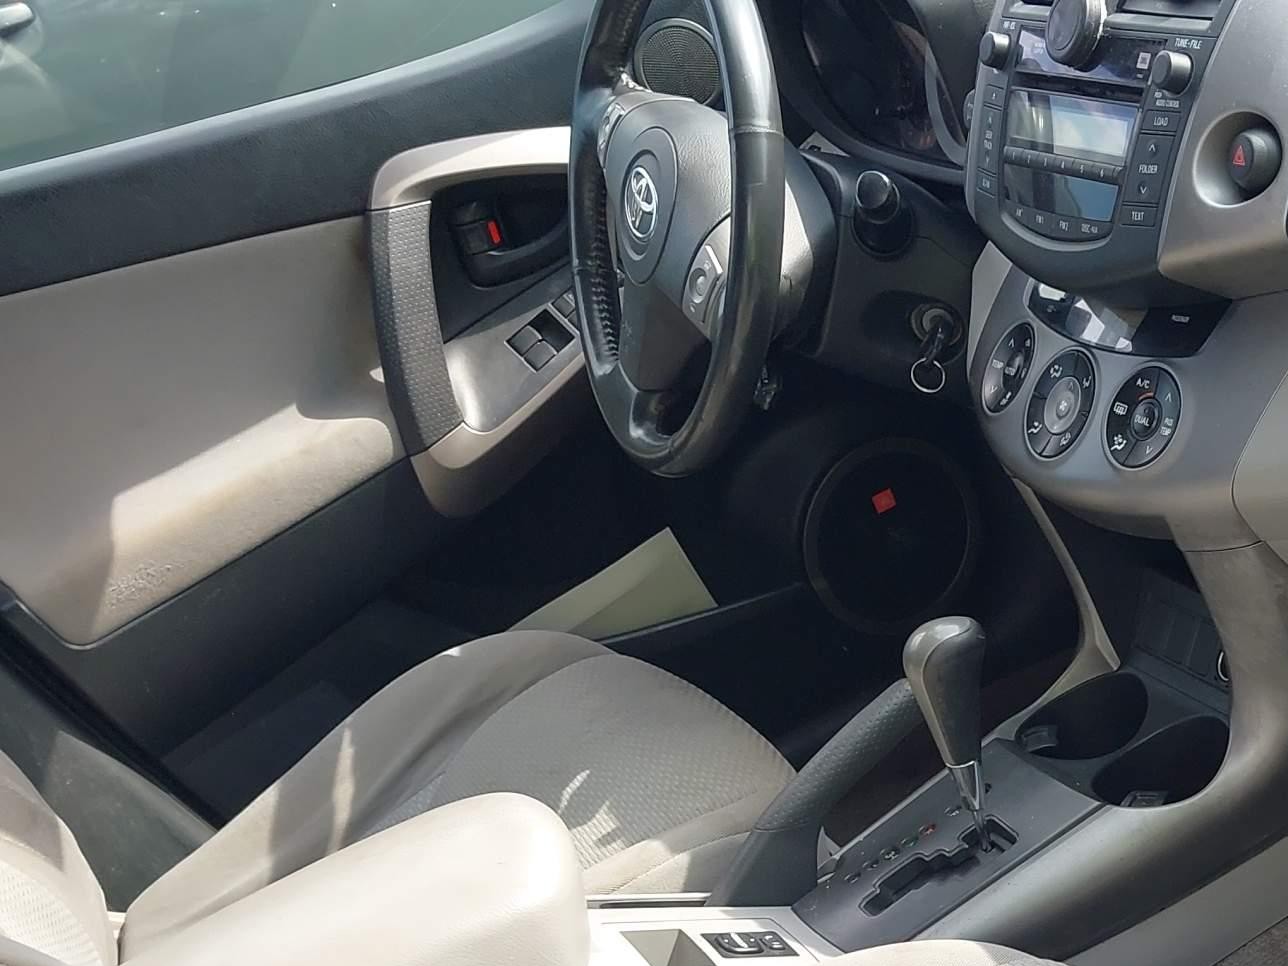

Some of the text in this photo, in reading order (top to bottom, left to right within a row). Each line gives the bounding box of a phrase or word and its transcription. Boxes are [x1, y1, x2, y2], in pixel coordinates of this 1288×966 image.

[1138, 164, 1158, 174] FOLDER
[1131, 211, 1145, 221] TEXT
[1136, 378, 1150, 389] A/C
[1134, 414, 1150, 427] DUAL
